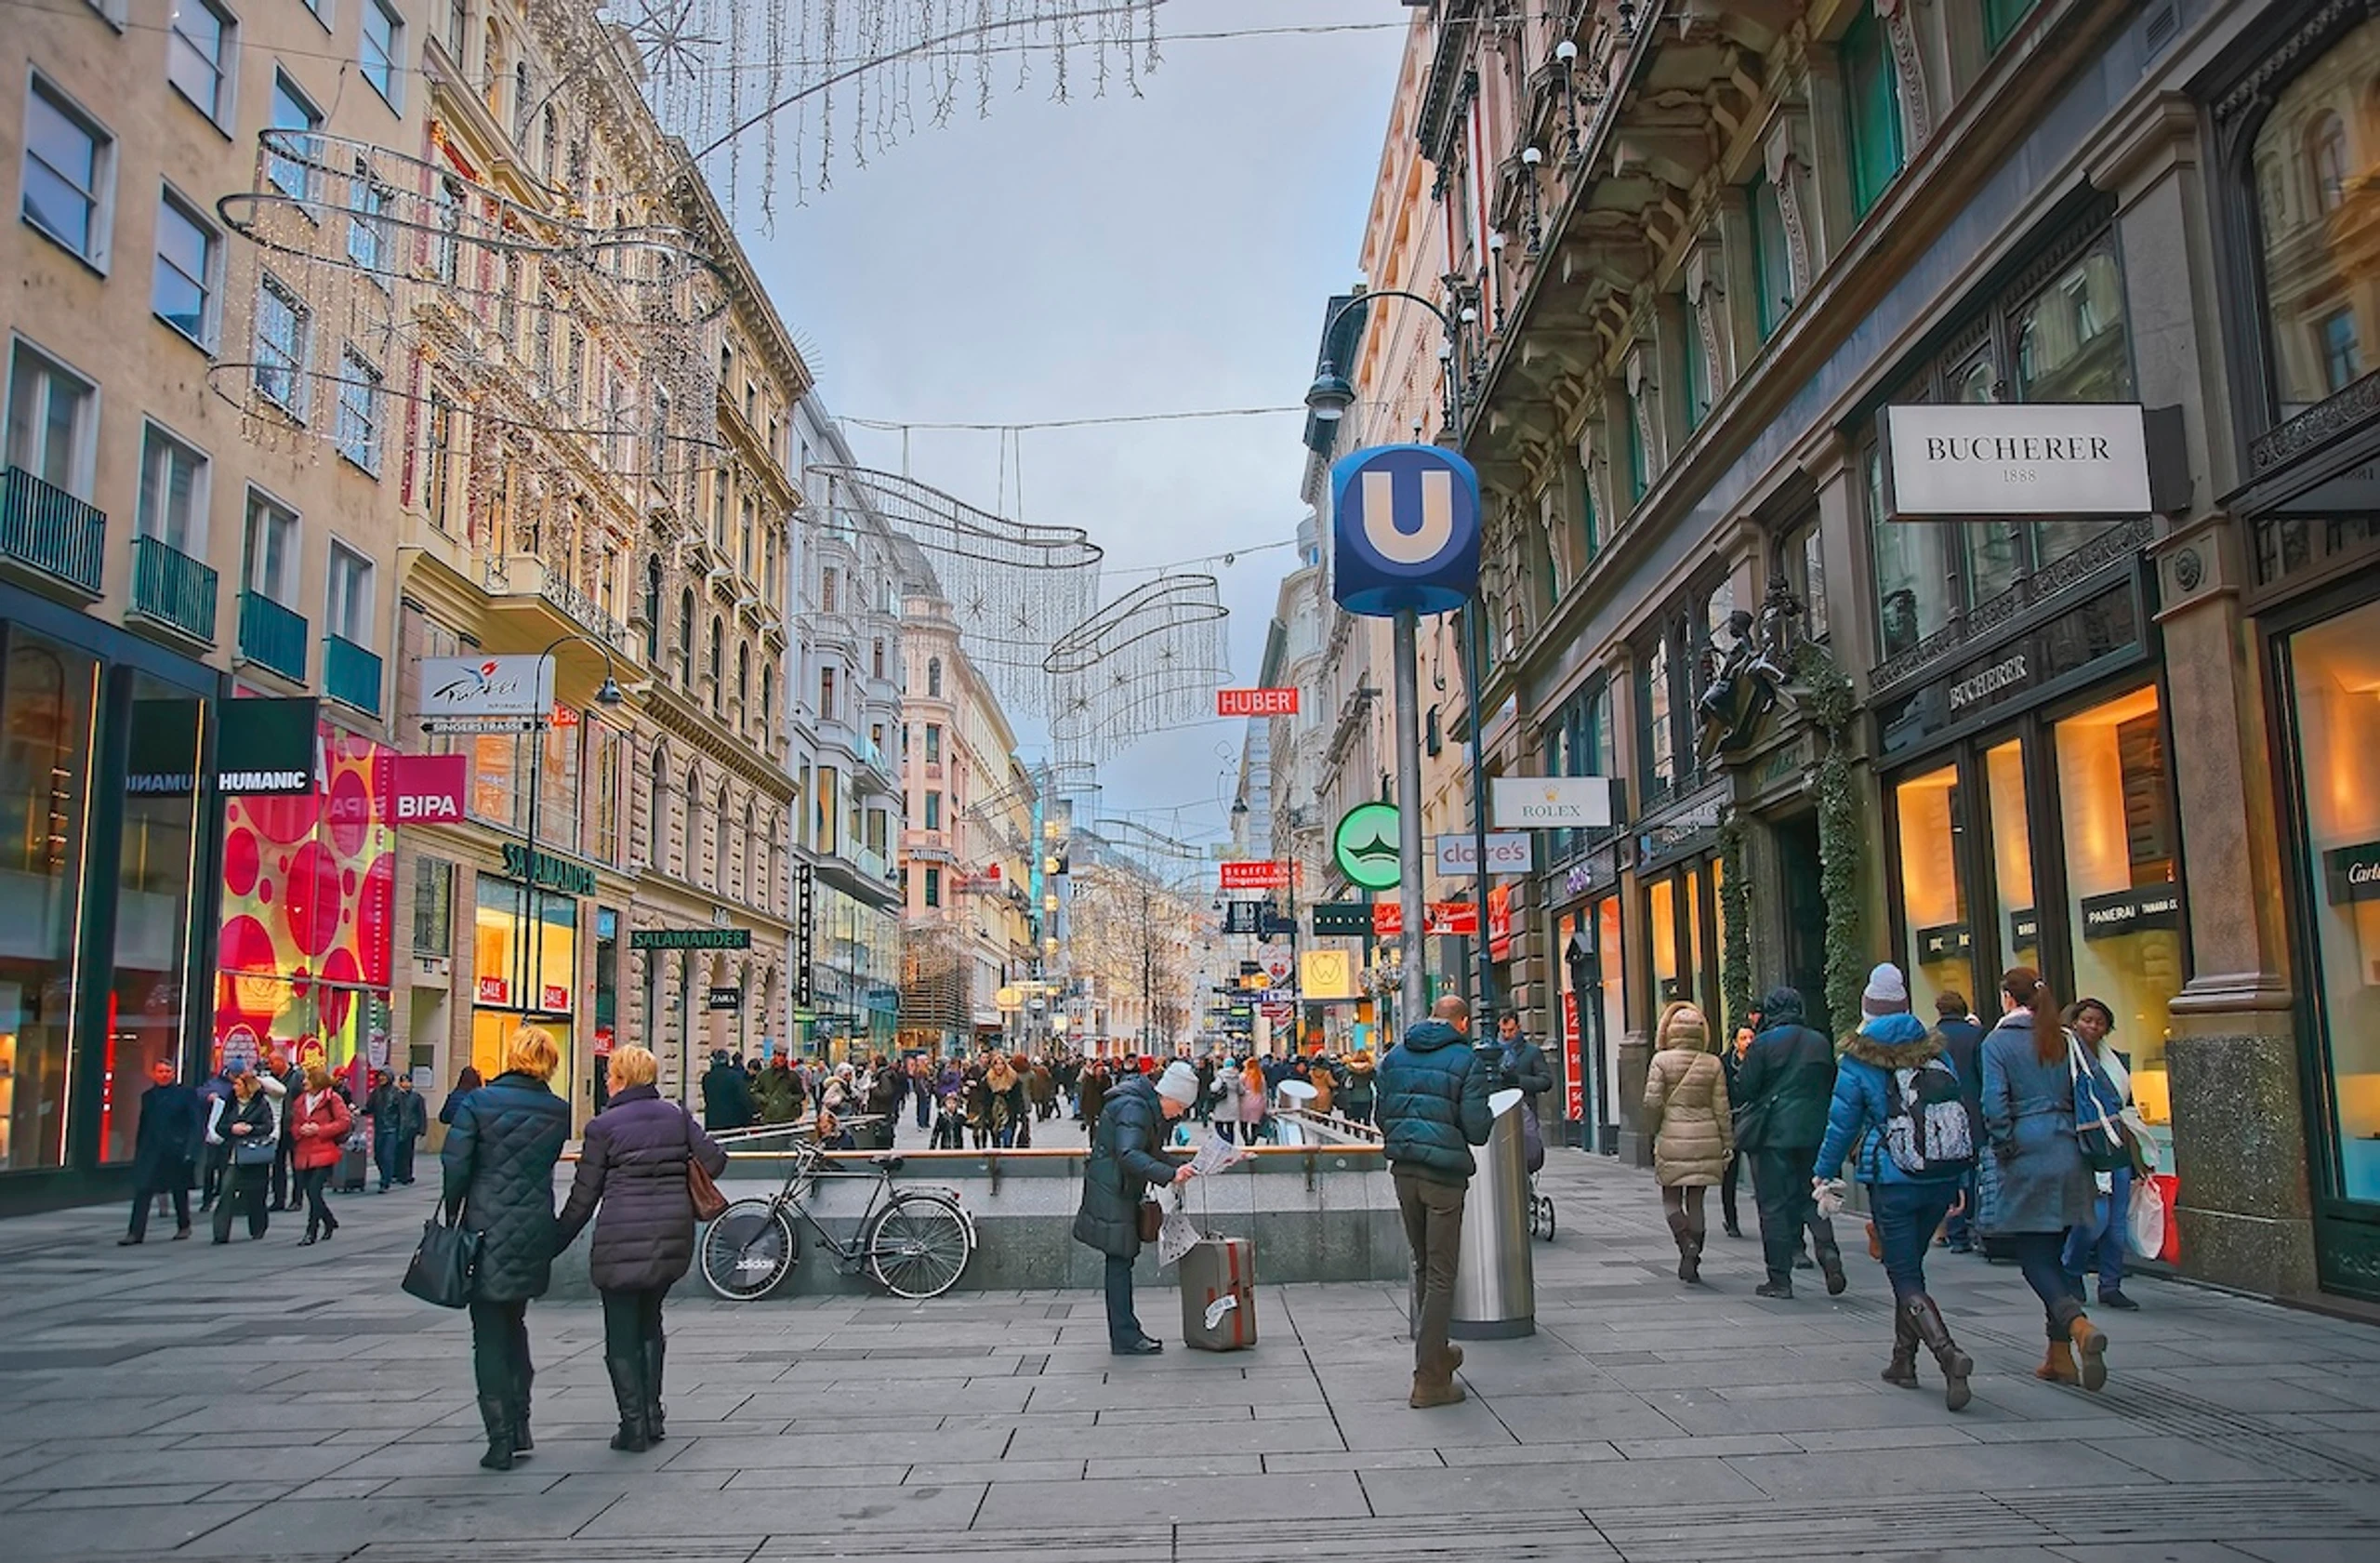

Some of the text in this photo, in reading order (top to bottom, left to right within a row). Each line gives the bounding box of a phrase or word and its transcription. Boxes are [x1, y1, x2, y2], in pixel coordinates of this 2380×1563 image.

[1925, 437, 2111, 461] BUCHERER
[2003, 469, 2037, 483] 1888
[1361, 470, 1453, 564] U
[1950, 655, 2027, 710] BUCHERER
[1222, 691, 1291, 712] HUBER
[218, 771, 307, 790] HUMANIC
[397, 795, 458, 817] BIPA
[1522, 804, 1580, 817] ROLEX
[1443, 841, 1525, 863] clare's
[502, 841, 596, 896] SAAMANDER
[2088, 905, 2135, 923] PANERAI
[634, 932, 745, 947] SALAMANDER
[481, 979, 500, 999] SALE
[545, 988, 562, 1005] SALE
[800, 976, 808, 1002] 21
[735, 1257, 774, 1270] adidas
